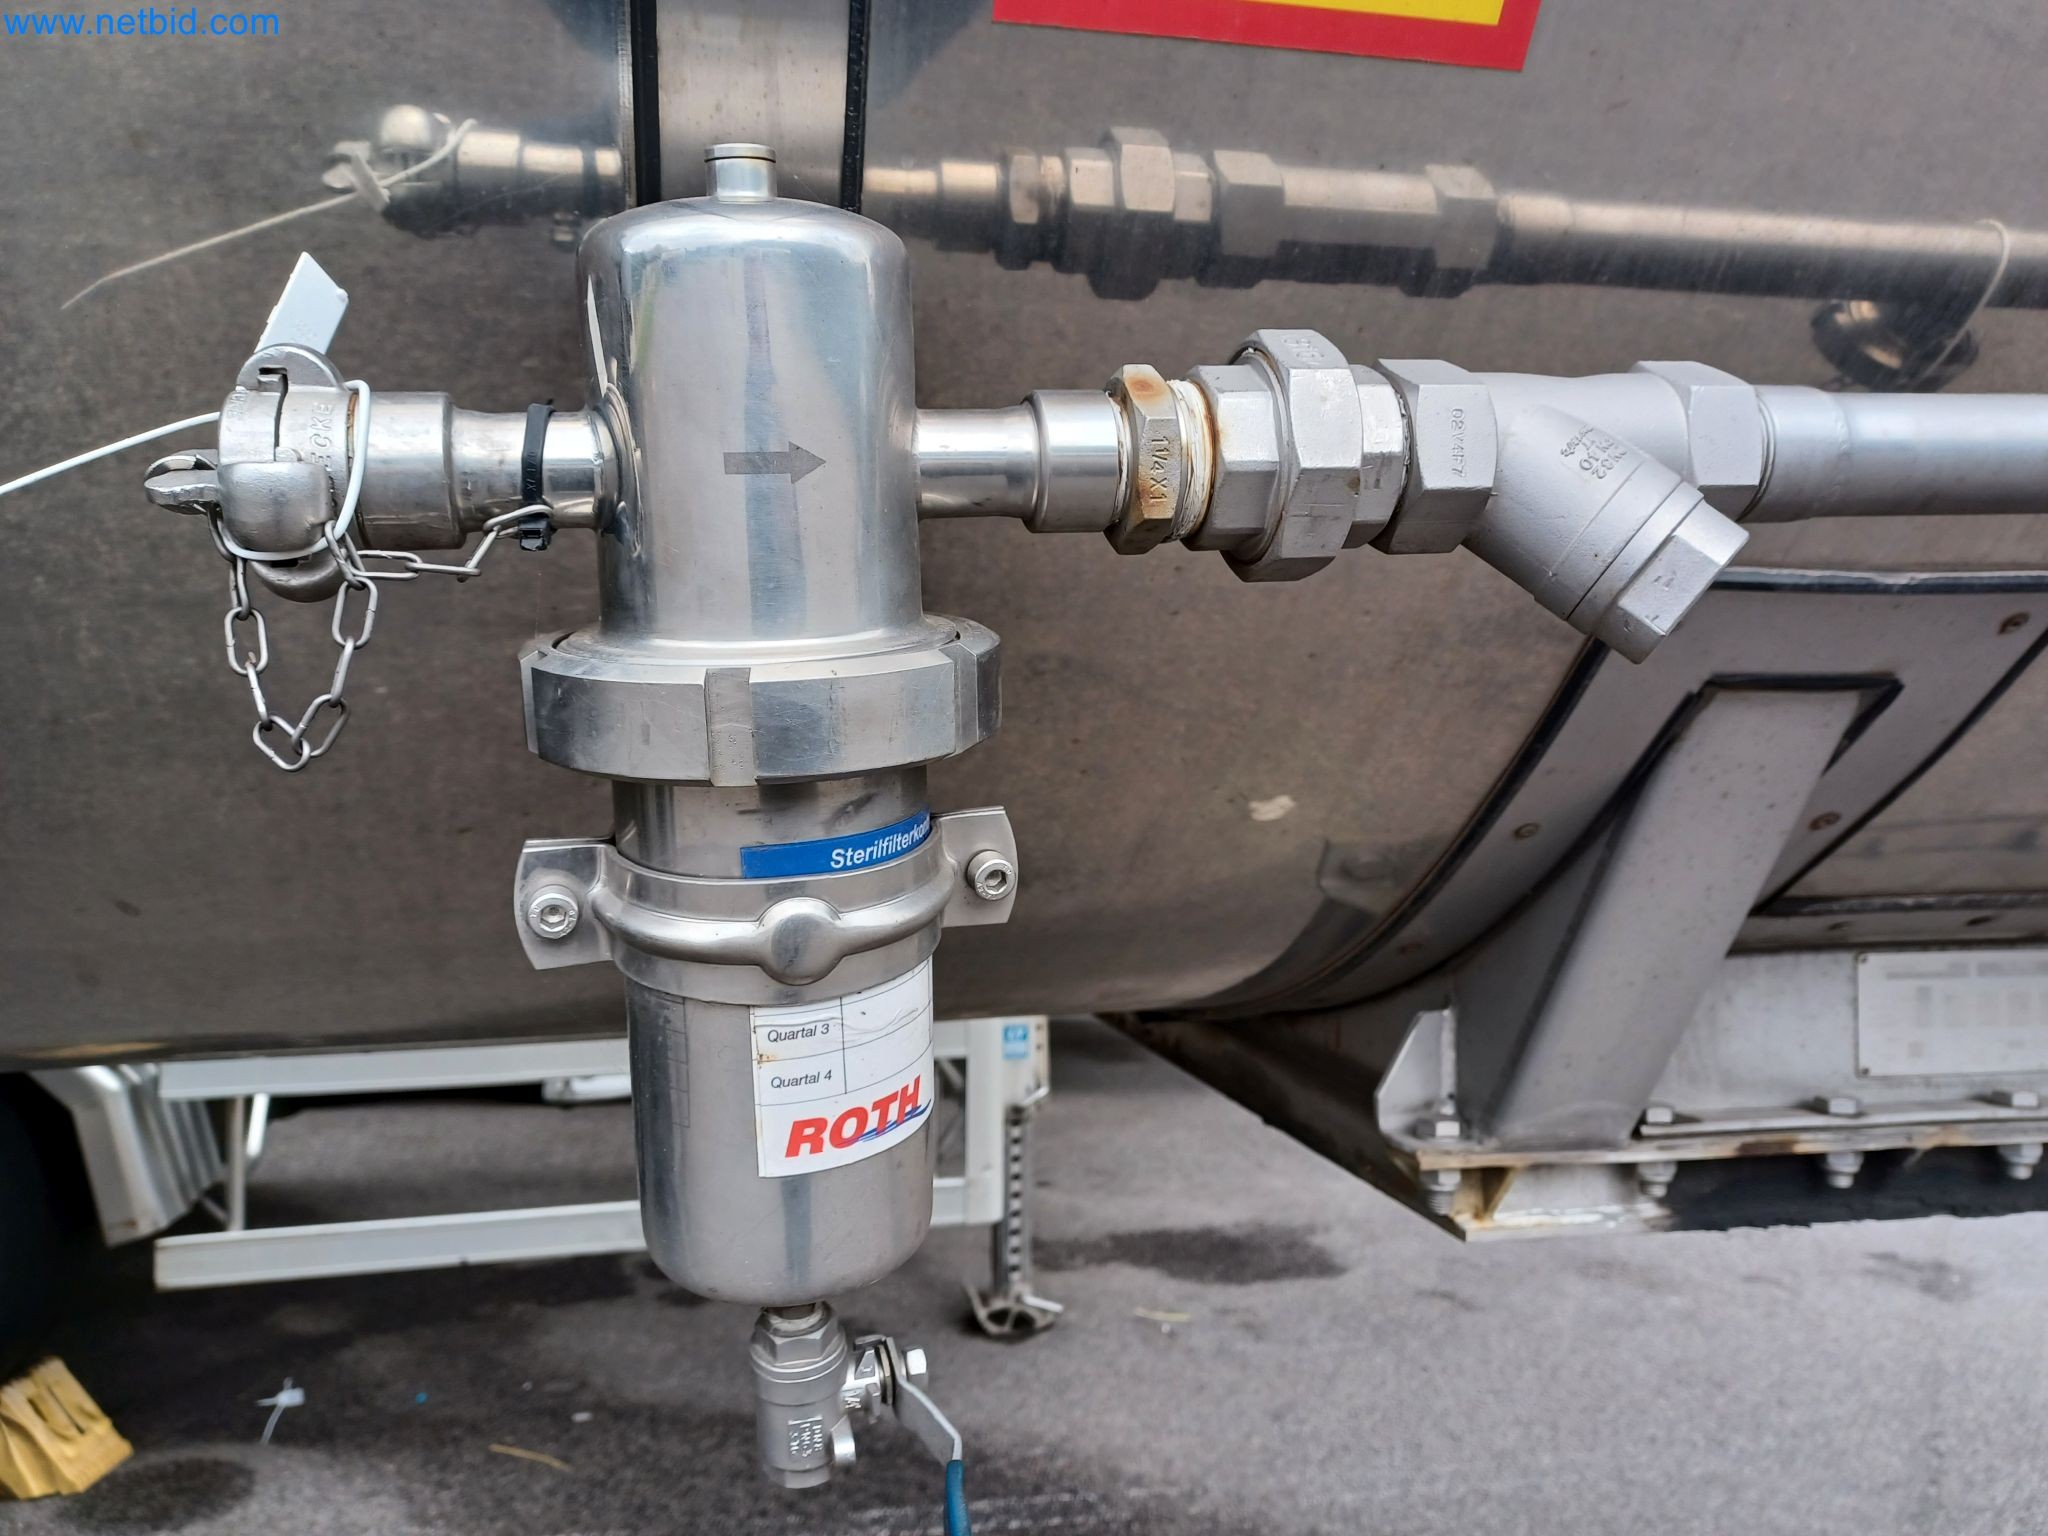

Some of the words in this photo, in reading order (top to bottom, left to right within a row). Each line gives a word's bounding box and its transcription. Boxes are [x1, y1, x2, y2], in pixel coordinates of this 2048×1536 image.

[767, 1023, 817, 1043] Quartal
[820, 1023, 830, 1035] 3
[770, 1071, 820, 1088] Quartal
[823, 1069, 832, 1081] 4
[785, 1074, 921, 1158] ROTH
